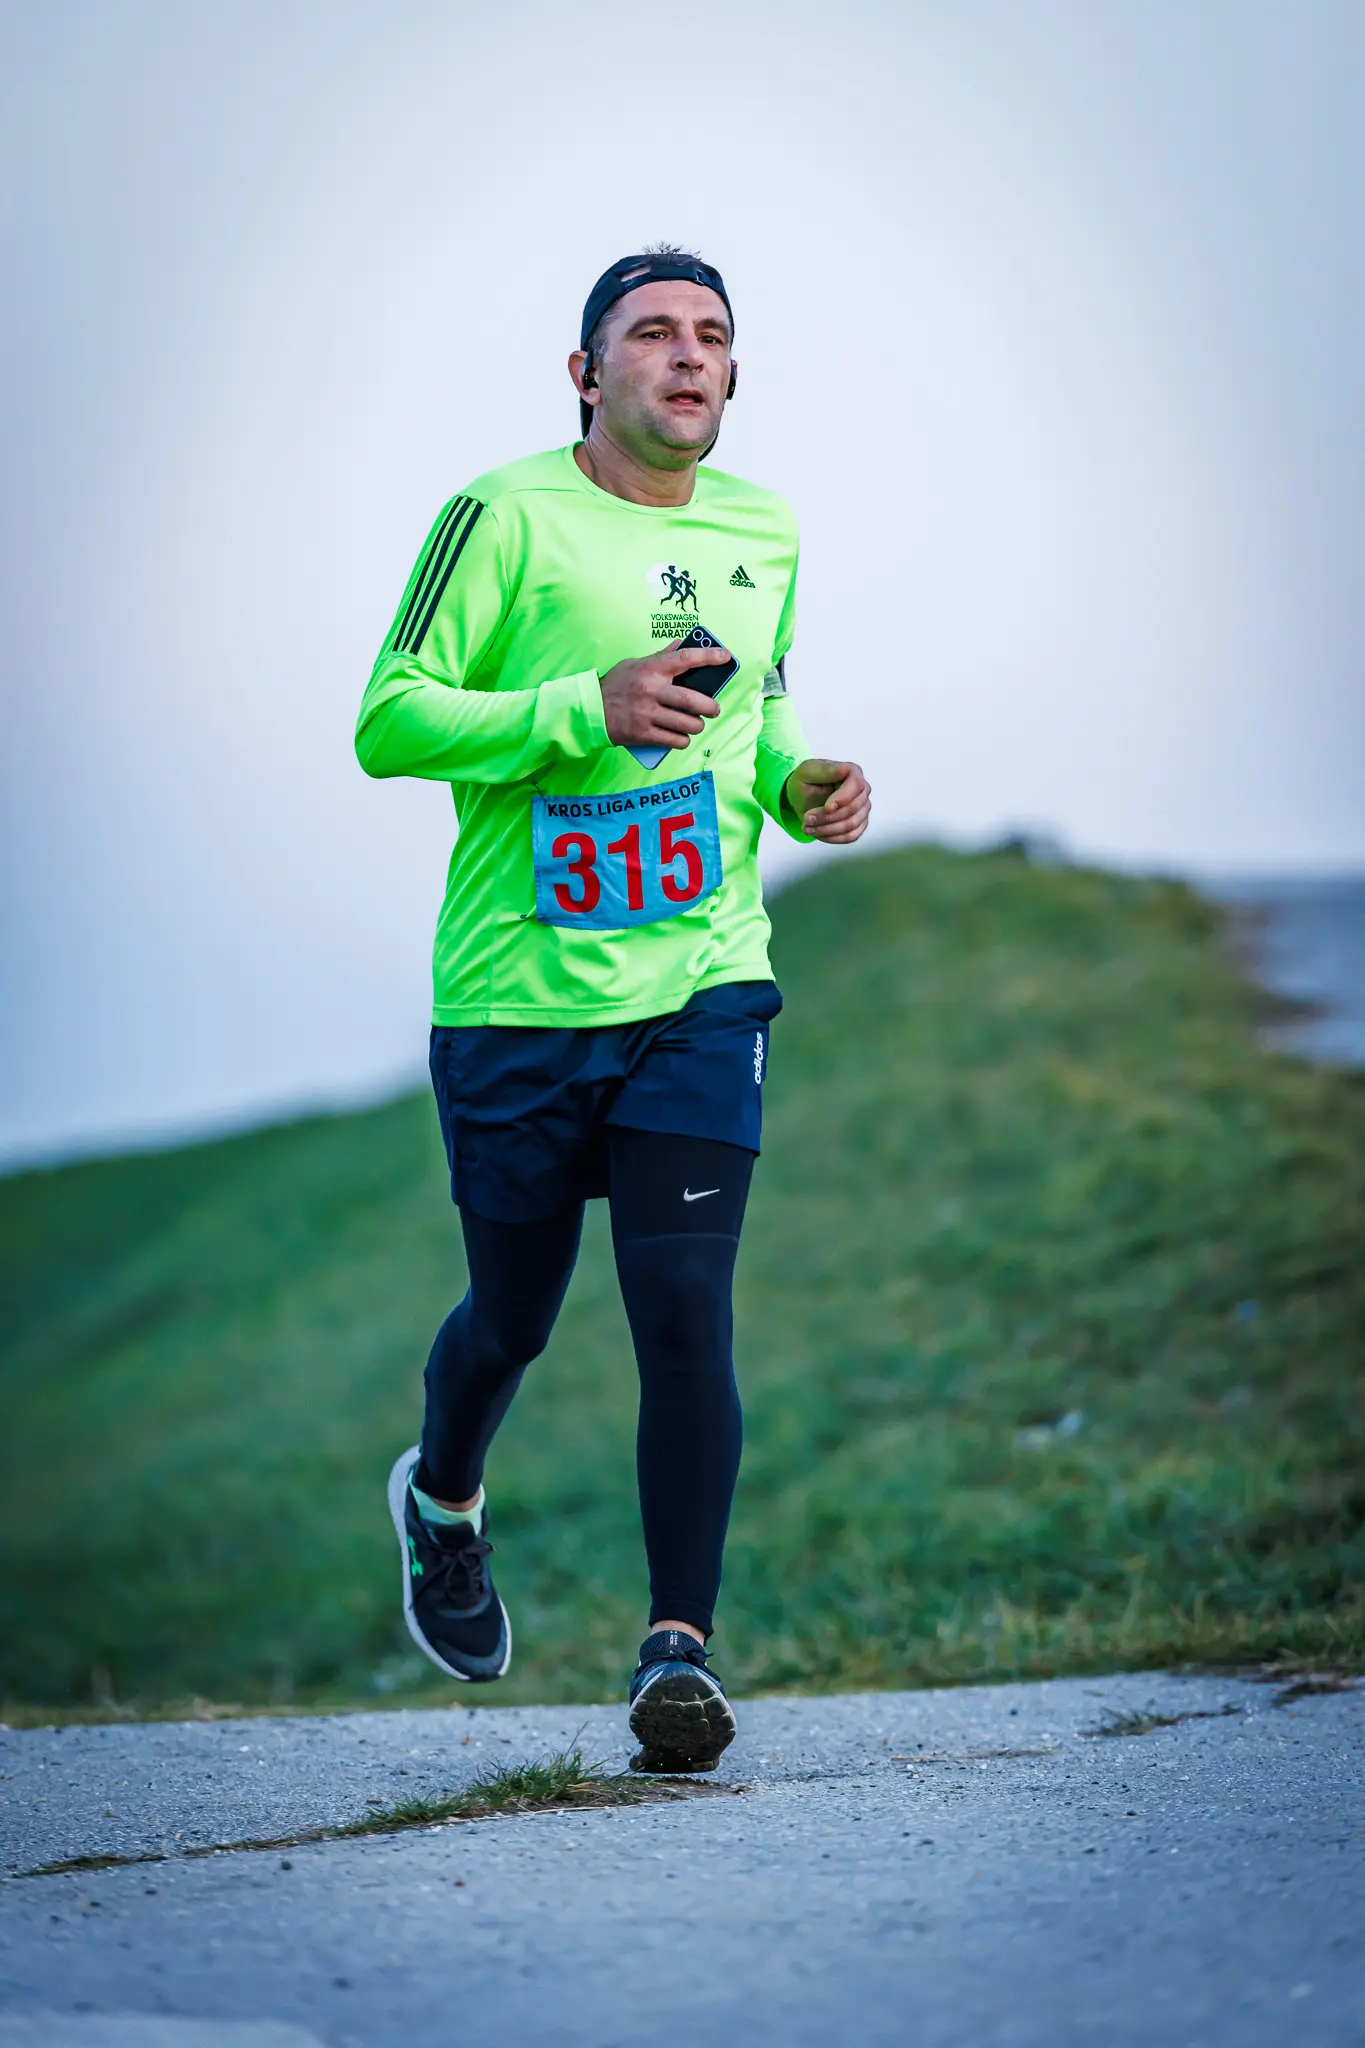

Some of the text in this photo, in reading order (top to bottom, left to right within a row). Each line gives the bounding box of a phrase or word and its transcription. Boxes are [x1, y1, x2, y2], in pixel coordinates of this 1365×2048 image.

[729, 579, 756, 589] adidas
[650, 613, 699, 621] VOLKSWAGEN
[651, 629, 692, 639] MARATO
[547, 781, 700, 818] KROS LIGA PRELOG
[552, 811, 704, 914] 315
[753, 1031, 764, 1085] adidas
